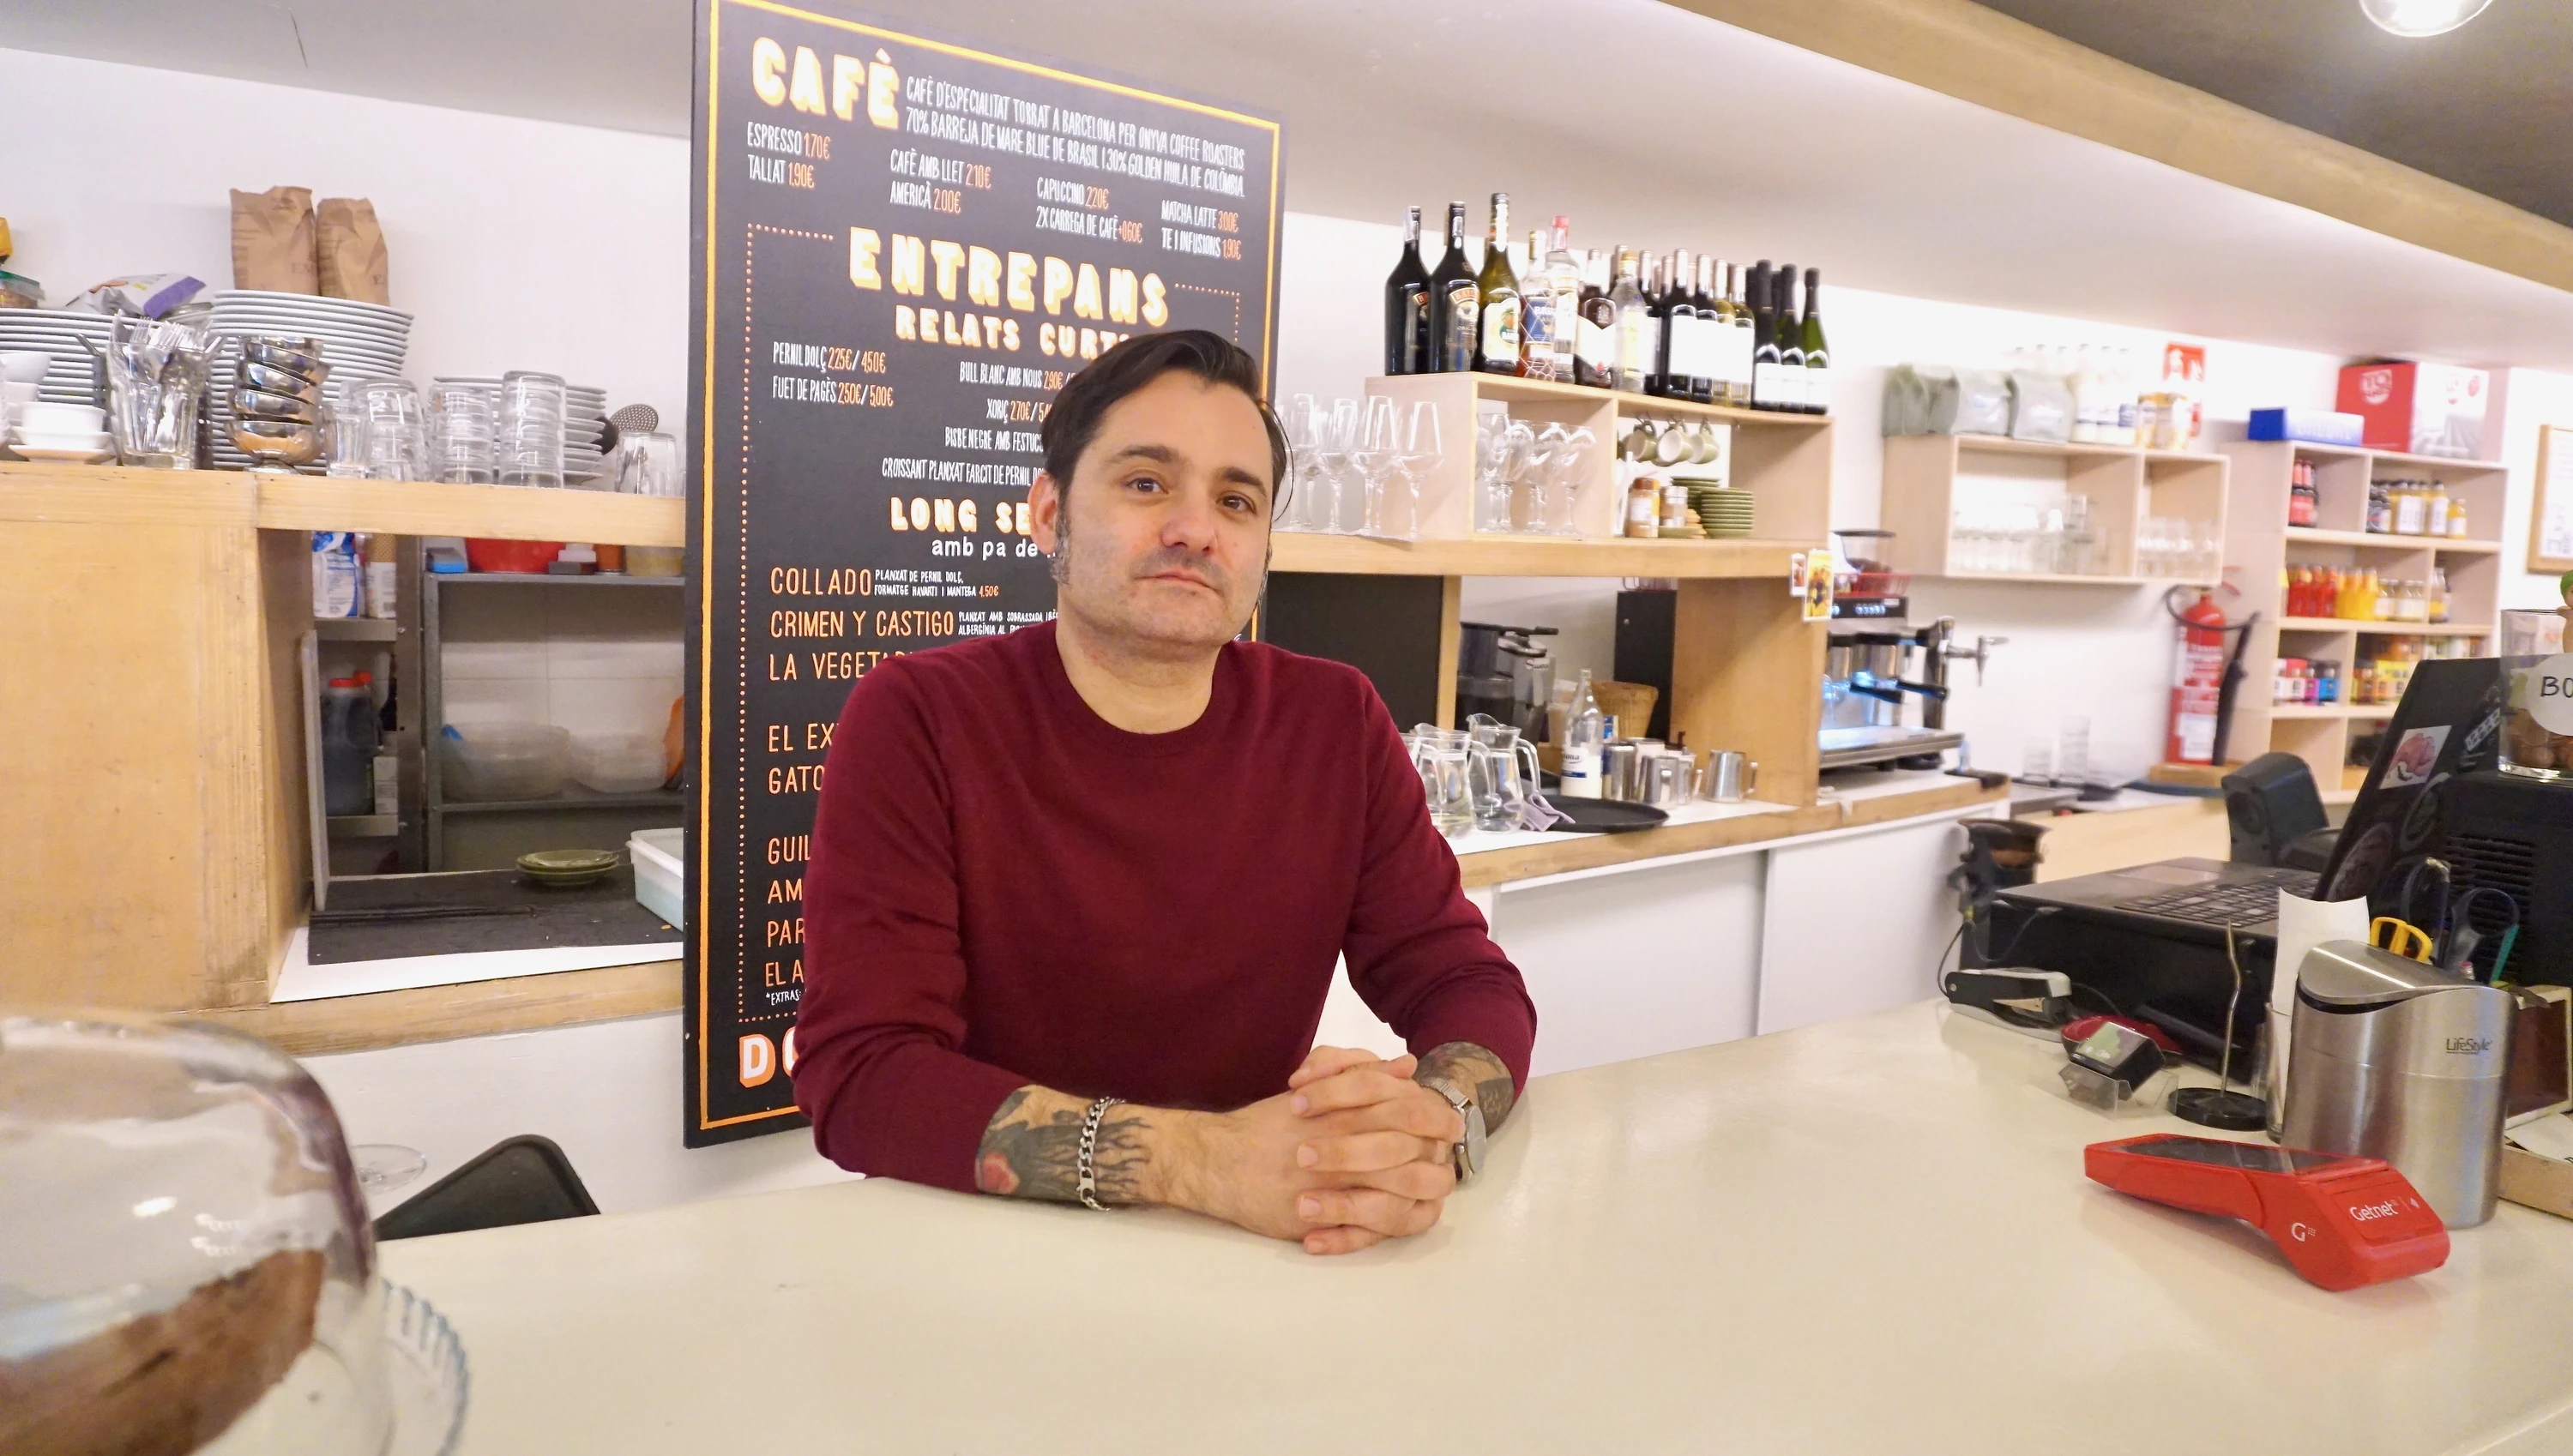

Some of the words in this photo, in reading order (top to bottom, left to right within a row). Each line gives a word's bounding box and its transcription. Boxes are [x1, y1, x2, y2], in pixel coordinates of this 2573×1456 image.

[752, 37, 900, 129] CAFÈ
[907, 75, 932, 105] CAFÈ
[937, 81, 1010, 121] D'ESPECIALITAT
[1013, 99, 1051, 129] TORRAT
[1052, 108, 1059, 131] A
[1063, 109, 1116, 143] BARCELONA
[1118, 122, 1136, 147] PER
[1170, 133, 1200, 161] COFFEE
[747, 121, 803, 156] ESPRESSO
[906, 106, 929, 134] 70%
[931, 111, 979, 145] BARREJA
[981, 122, 995, 148] DE
[1027, 131, 1050, 159] BLUE
[1053, 136, 1064, 161] DE
[1068, 140, 1099, 169] BRASIL
[1129, 153, 1162, 181] GOLDEN
[1164, 159, 1188, 186] HUILA
[1190, 166, 1202, 188] DE
[747, 154, 786, 184] TALLAT
[890, 148, 916, 176] CAFÈ
[918, 154, 940, 179] AMB
[942, 159, 965, 184] LLET
[889, 180, 931, 209] AMERICÀ
[1037, 177, 1084, 206] CAPUCCINO
[1036, 205, 1048, 228] 2X
[1050, 208, 1084, 235] CARREGA
[1087, 214, 1097, 236] DE
[1100, 214, 1118, 241] CAFÈ
[1161, 200, 1191, 226] MATCHA
[1194, 206, 1218, 229] LATTE
[1162, 227, 1172, 250] TE
[1179, 231, 1220, 258] INFUSIONS
[850, 226, 1168, 328] ENTREPANS
[895, 304, 1021, 352] RELATS
[773, 341, 804, 367] PERNIL
[804, 346, 827, 374] DOLÇ
[960, 361, 978, 383] BULL
[980, 363, 1004, 385] BLANC
[1006, 366, 1021, 387] AMB
[1022, 368, 1042, 388] NOUS
[773, 376, 795, 400] FUET
[797, 377, 808, 400] DE
[810, 376, 836, 403] PAGÈS
[986, 398, 1009, 424] XORIÇ
[945, 426, 967, 449] BISBE
[968, 429, 992, 451] NEGRE
[994, 430, 1010, 452] AMB
[882, 457, 928, 479] CROISSANT
[929, 460, 965, 483] PLANXAT
[966, 462, 992, 484] FARCIT
[993, 465, 1004, 485] DE
[1005, 465, 1031, 486] PERNIL
[889, 496, 978, 532] LONG
[931, 537, 973, 557] amb
[982, 540, 1006, 561] pa
[1015, 538, 1038, 557] de
[770, 567, 871, 596] COLLADO
[875, 569, 907, 582] PLANXAT
[909, 570, 918, 582] DE
[920, 571, 943, 583] PERNIL
[874, 585, 908, 596] FORMATGE
[912, 586, 937, 597] HAVARTI
[947, 586, 976, 597] MANTEGA
[770, 611, 844, 638] CRIMEN
[851, 611, 866, 636] Y
[876, 610, 954, 637] CASTIGO
[958, 611, 986, 622] PLANXAT
[988, 611, 1003, 623] AMB
[1007, 611, 1043, 623] SOBRASSADA
[958, 623, 995, 635] ALBERGÍNIA
[997, 624, 1005, 635] AL
[769, 653, 797, 681] LA
[811, 651, 913, 680] VEGET
[768, 725, 793, 752] EL
[807, 723, 839, 749] EX
[765, 961, 786, 987] EL
[2350, 1201, 2398, 1221] Getnet
